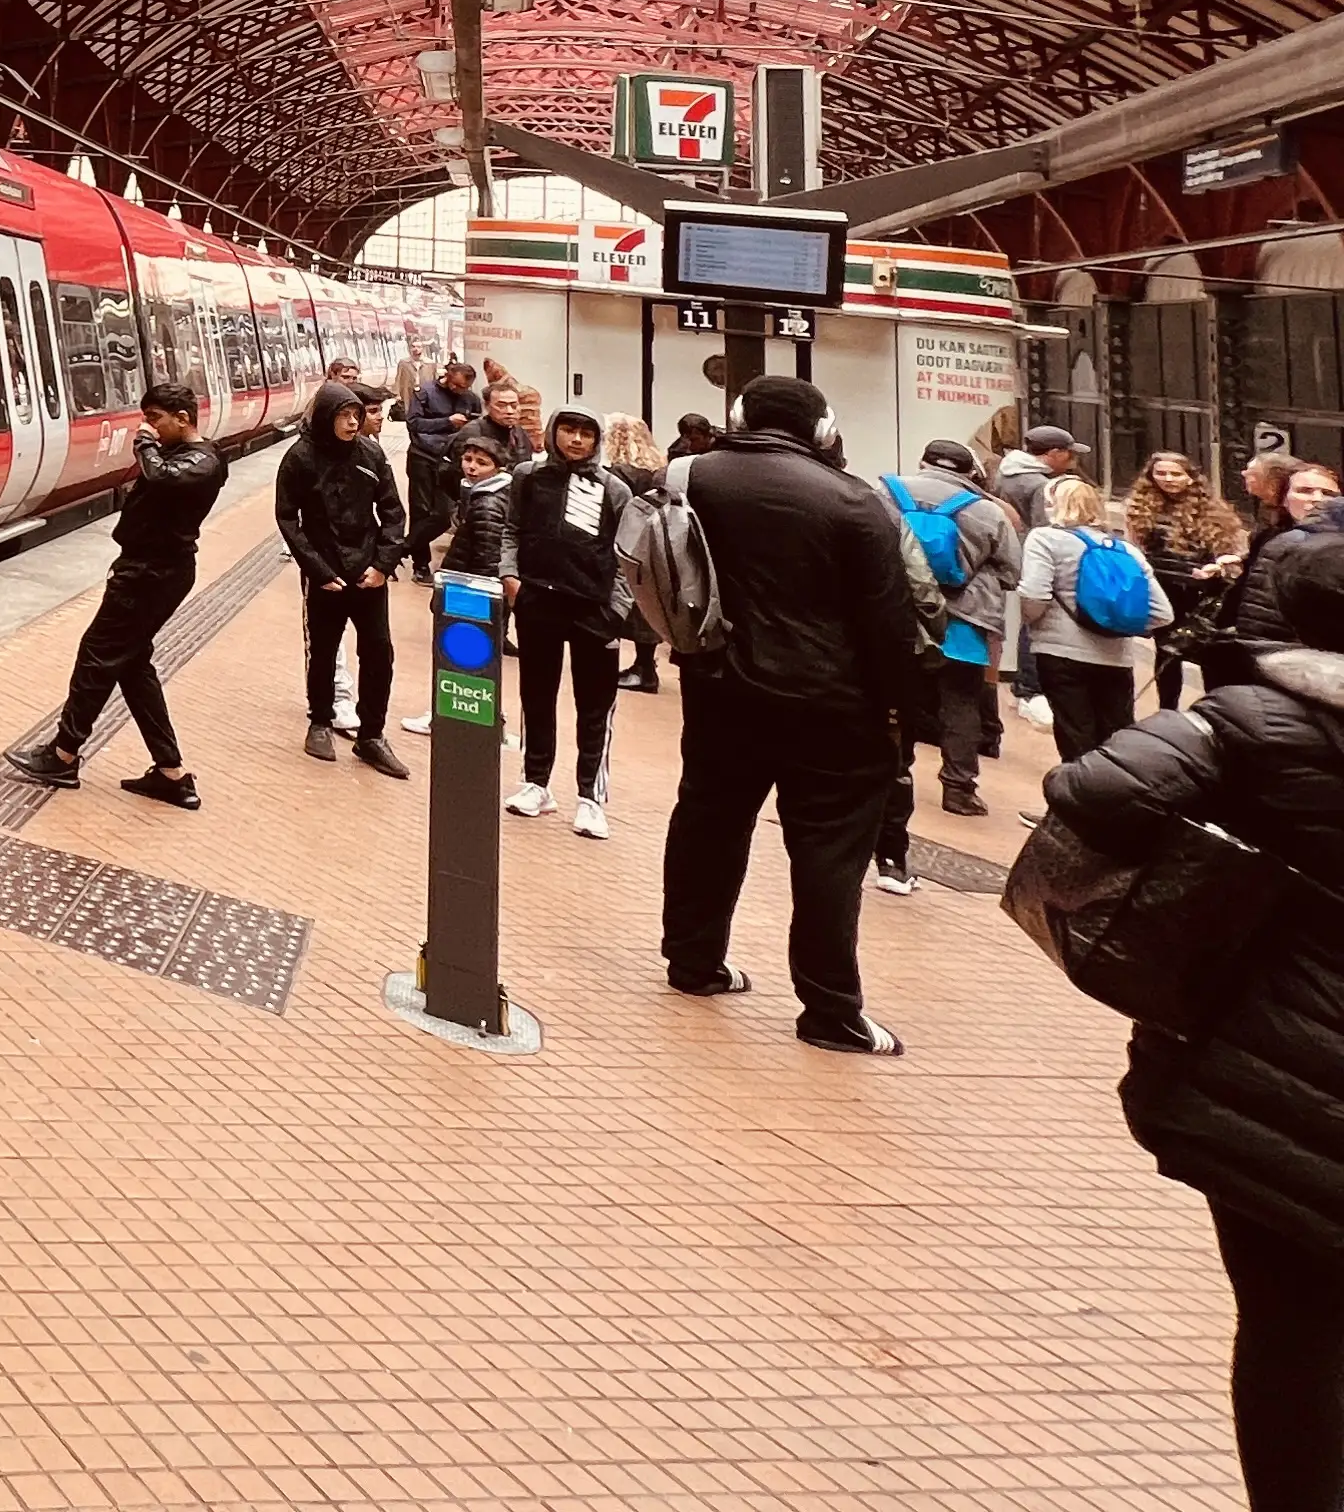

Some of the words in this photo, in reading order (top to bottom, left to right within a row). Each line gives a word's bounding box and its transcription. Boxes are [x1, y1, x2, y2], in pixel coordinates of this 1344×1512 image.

[682, 310, 713, 329] 11
[916, 337, 935, 351] DU
[939, 340, 966, 354] KAN
[917, 371, 933, 383] AT
[937, 373, 981, 389] SKULLE
[917, 387, 932, 400] ET
[564, 472, 605, 537] NIKE
[439, 679, 494, 703] Check
[451, 696, 480, 715] ind
